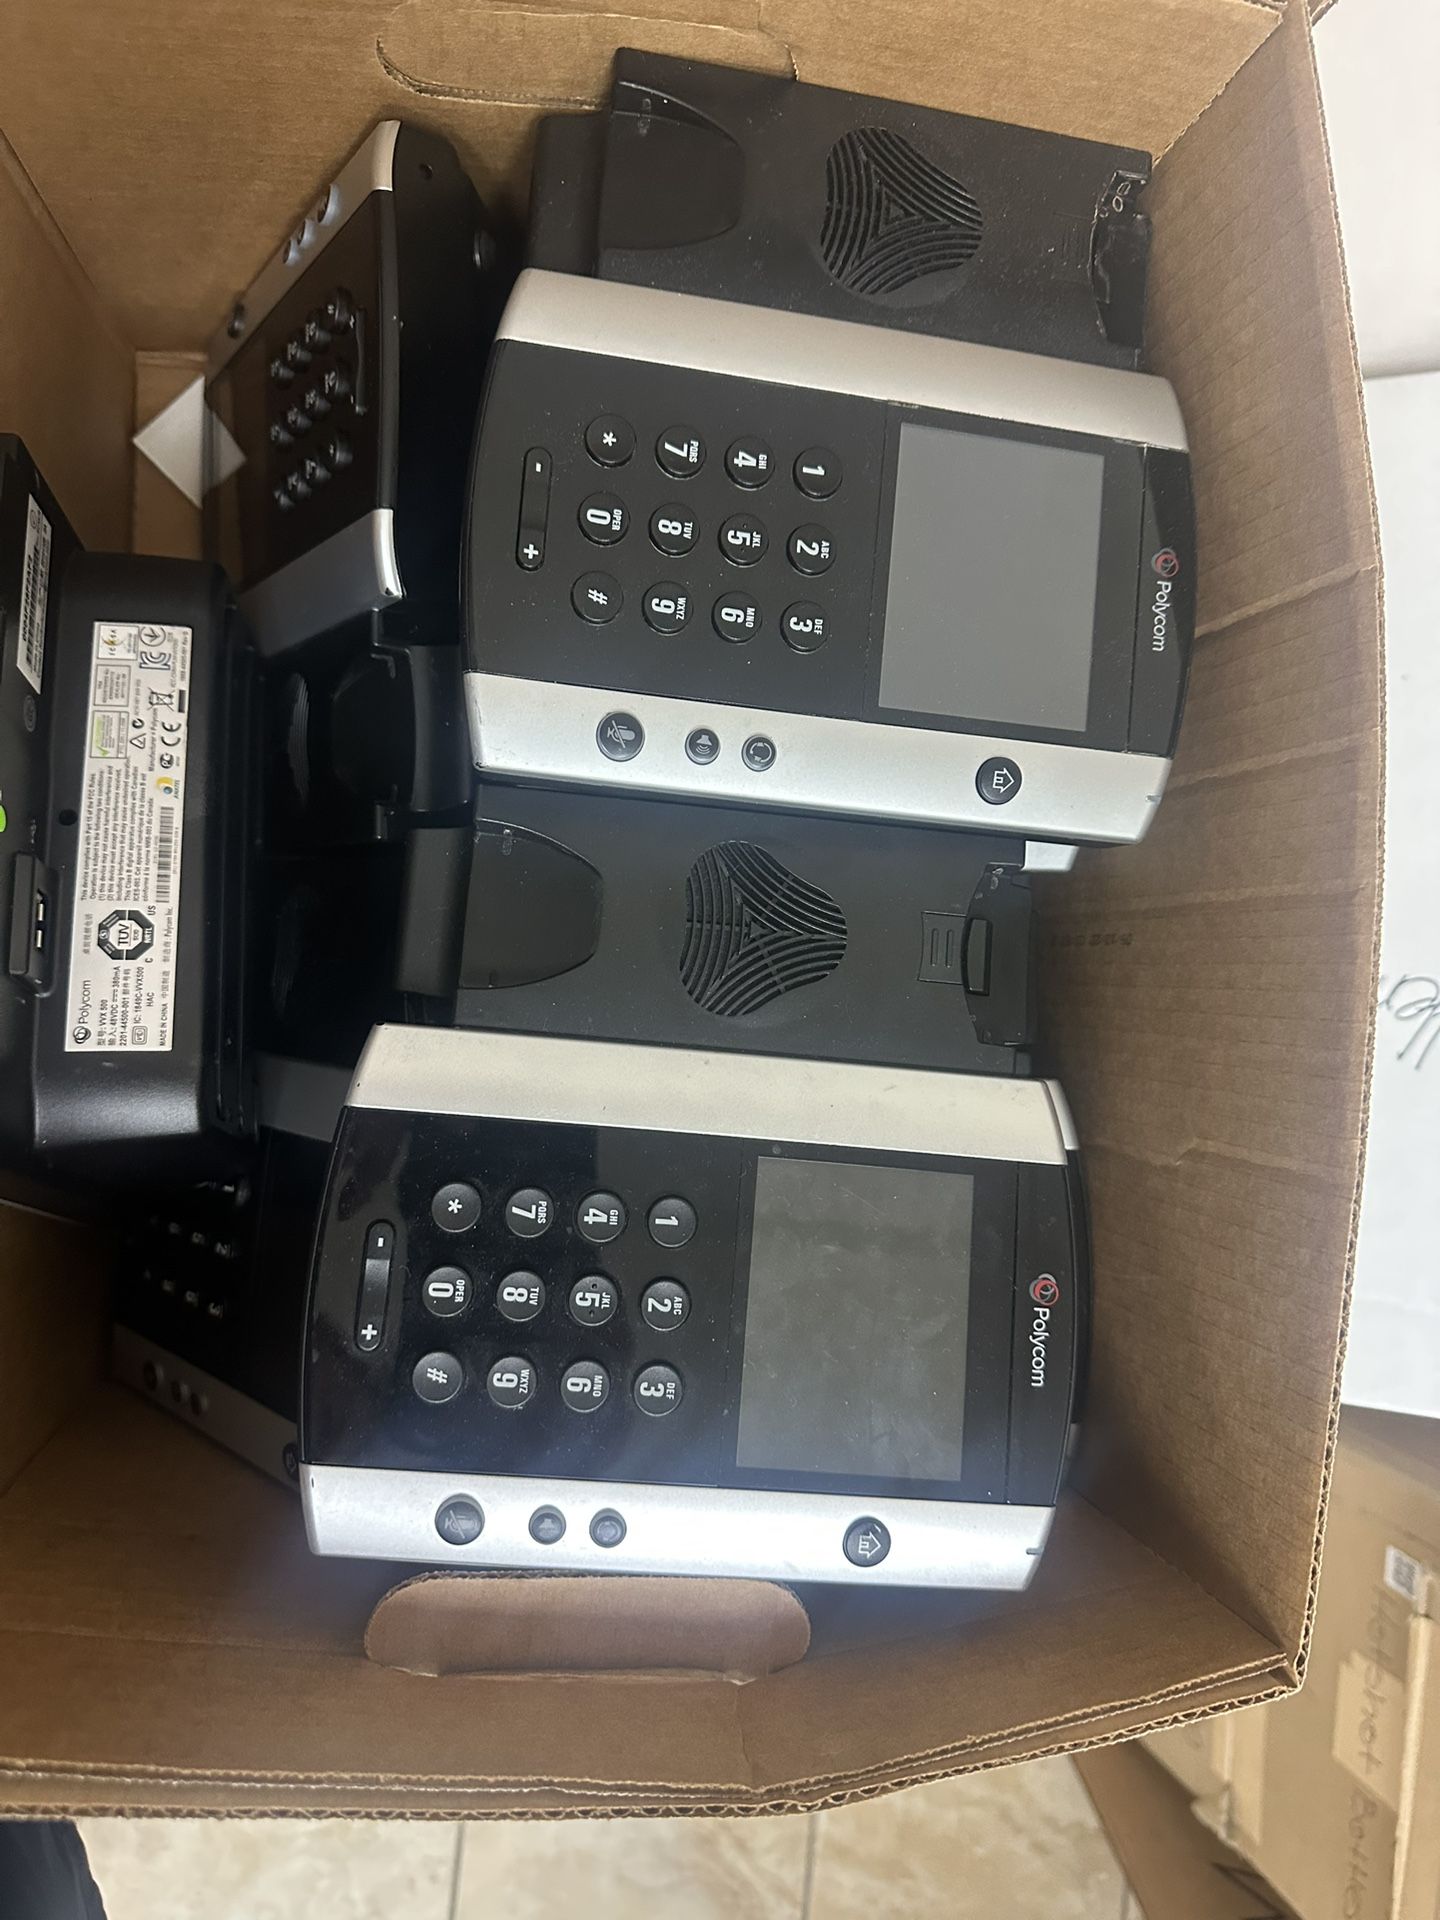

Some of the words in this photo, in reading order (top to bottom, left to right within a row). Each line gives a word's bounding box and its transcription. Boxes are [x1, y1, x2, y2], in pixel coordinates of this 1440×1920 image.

[665, 442, 688, 458] 7
[734, 451, 756, 467] 4
[758, 454, 767, 469] GHI
[802, 466, 825, 476] 1
[587, 509, 611, 525] 0
[612, 509, 623, 531] OPER
[658, 519, 682, 535] 8
[683, 522, 692, 540] TUV
[728, 530, 751, 546] 5
[752, 532, 761, 548] JKL
[797, 540, 819, 556] 2
[820, 540, 830, 559] ABC
[651, 598, 675, 614] 9
[676, 598, 686, 620] WXYZ
[721, 607, 744, 624] 6
[746, 607, 755, 628] MNO
[1151, 580, 1170, 652] Polycom
[790, 617, 812, 633] 3
[814, 619, 823, 635] DEF
[90, 873, 98, 898] Operation
[95, 808, 103, 831] following
[117, 846, 125, 876] interference
[126, 851, 134, 867] digital
[144, 927, 152, 943] NRTL
[78, 979, 93, 1024] Polycom
[100, 999, 108, 1010] 500
[99, 1012, 107, 1026] VVX
[110, 1004, 118, 1025] 48VDC
[512, 1205, 536, 1219] 7
[584, 1208, 608, 1225] 4
[609, 1210, 618, 1226] GHI
[655, 1216, 679, 1226] 1
[428, 1282, 454, 1298] 0
[455, 1279, 465, 1303] OPER
[503, 1287, 528, 1303] 8
[529, 1287, 539, 1306] TUV
[576, 1292, 600, 1307] 5
[601, 1292, 610, 1309] JKL
[648, 1298, 672, 1312] 2
[673, 1297, 682, 1316] ABC
[1029, 1307, 1050, 1388] Polycom
[493, 1373, 518, 1388] 9
[519, 1369, 530, 1394] WXYZ
[567, 1378, 592, 1393] 6
[592, 1375, 603, 1397] MNO
[640, 1382, 664, 1398] 3
[666, 1382, 675, 1400] DEF
